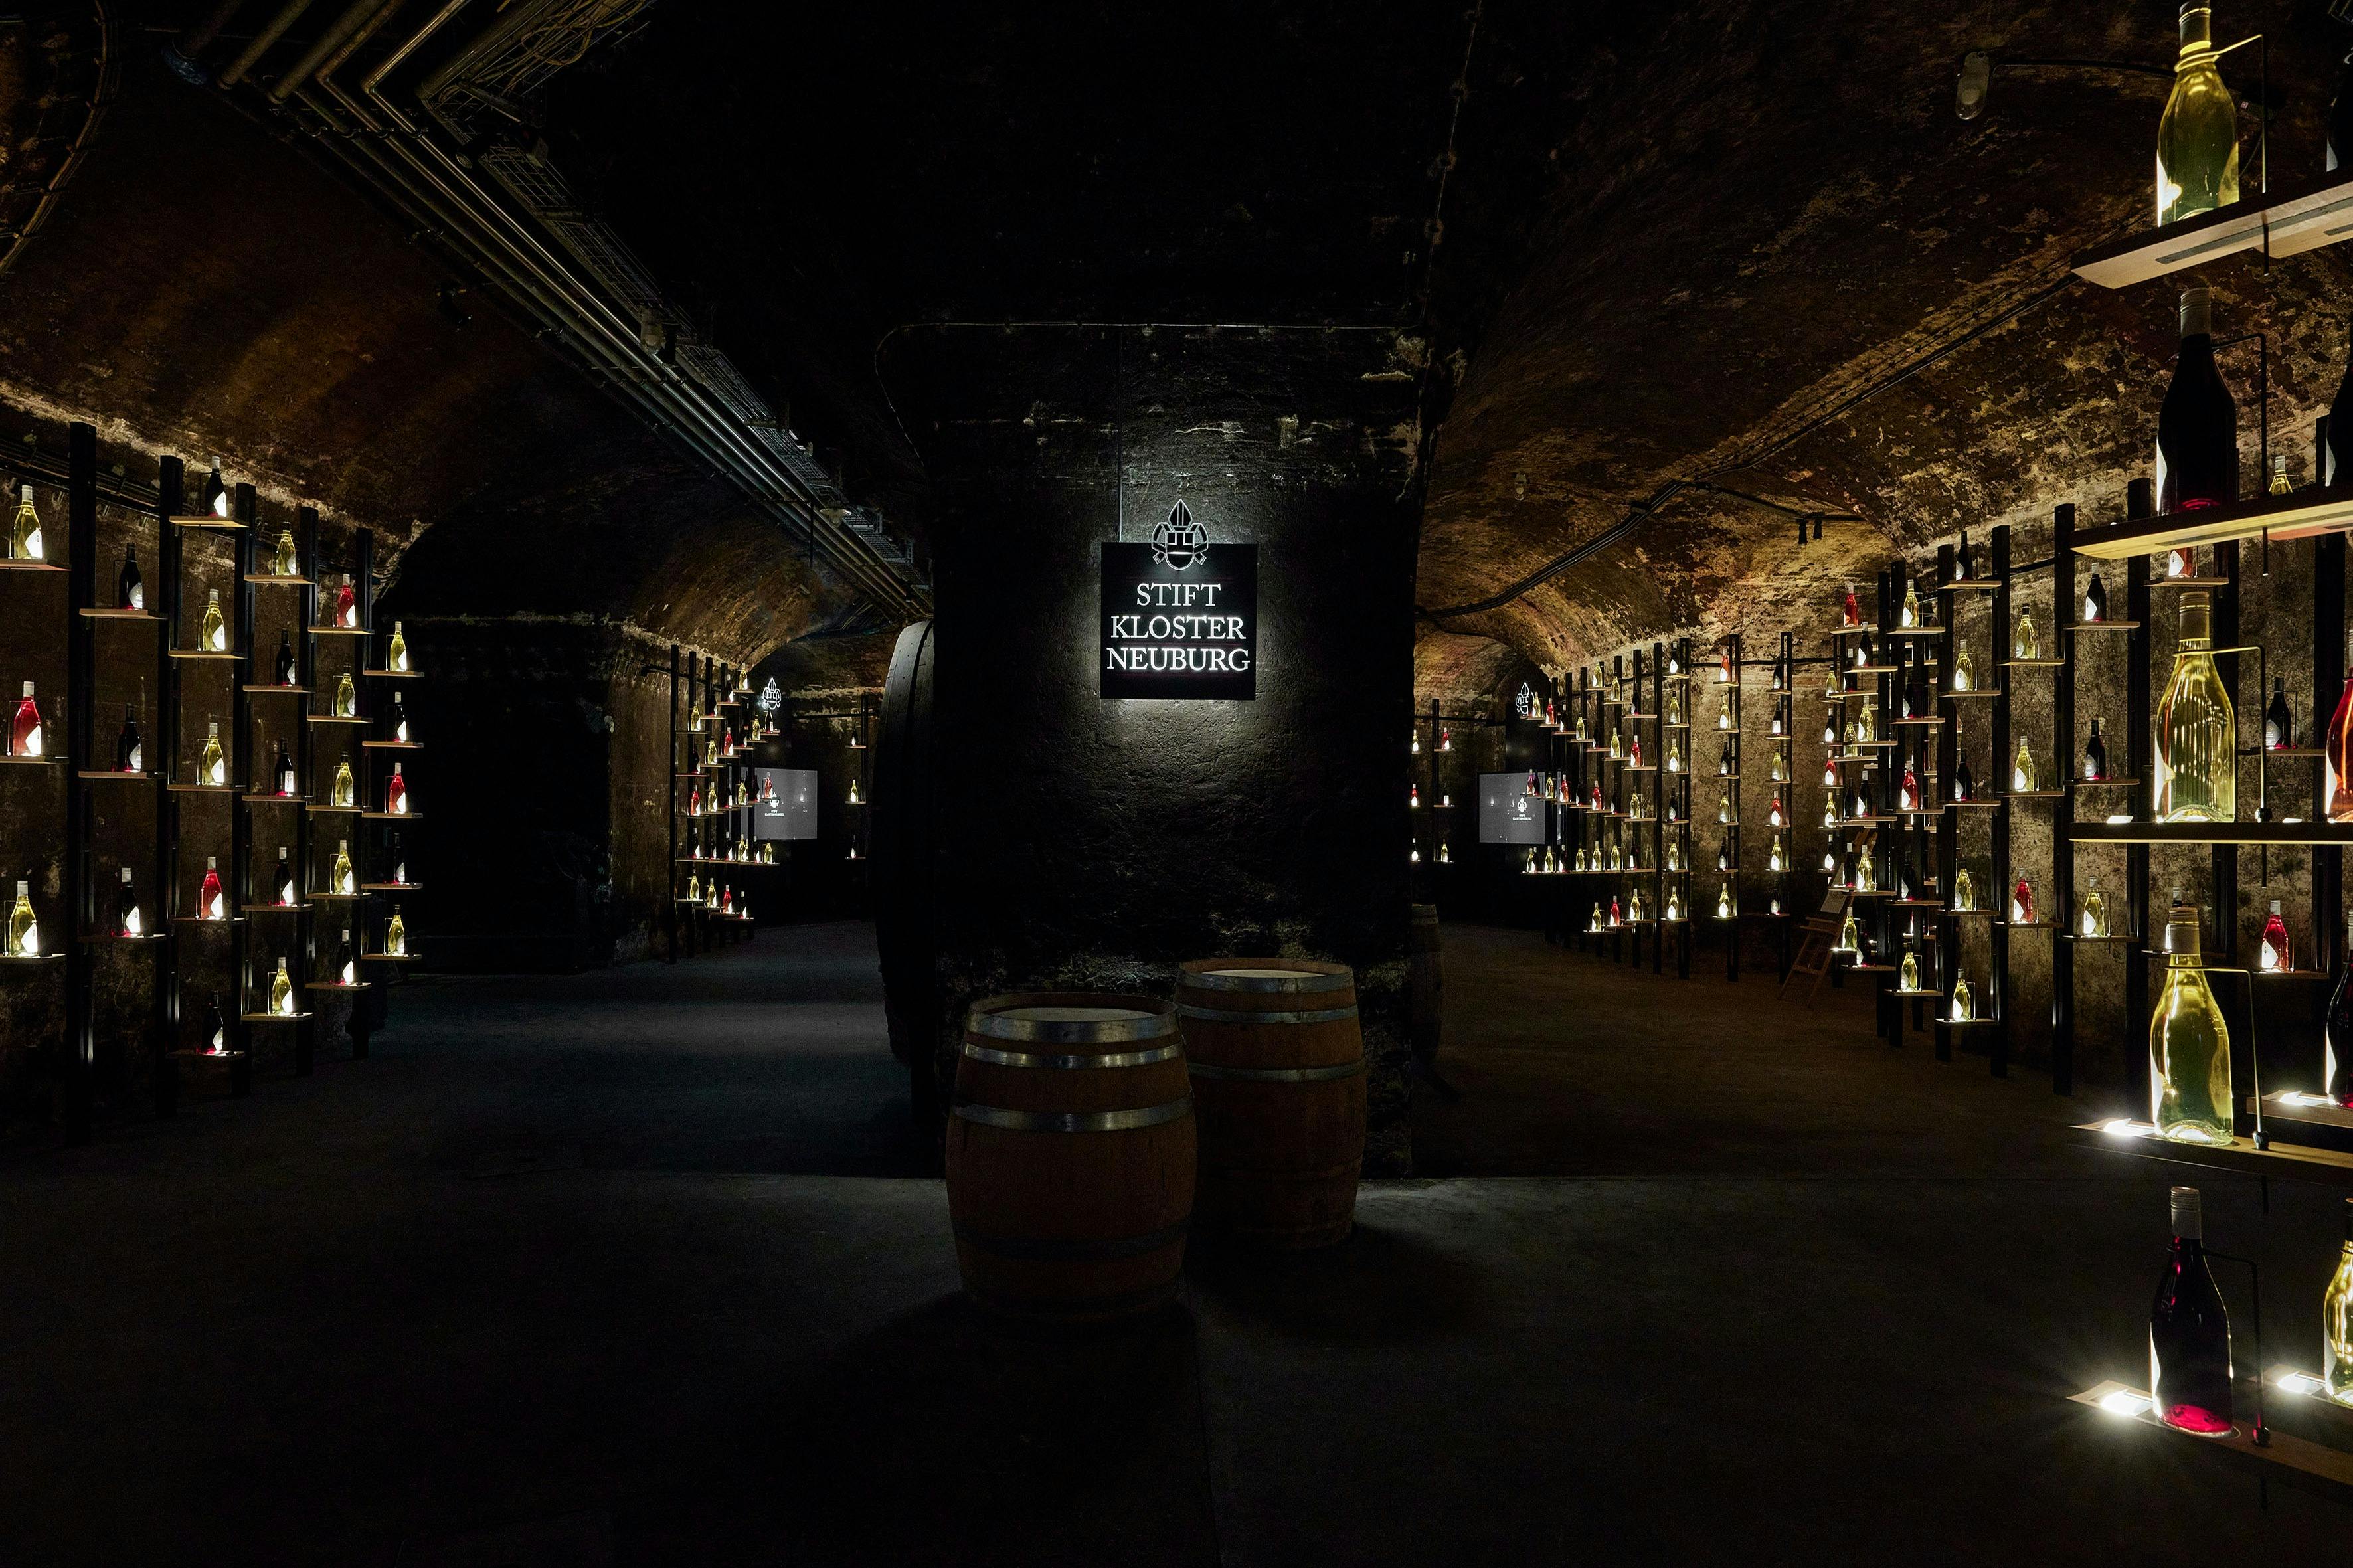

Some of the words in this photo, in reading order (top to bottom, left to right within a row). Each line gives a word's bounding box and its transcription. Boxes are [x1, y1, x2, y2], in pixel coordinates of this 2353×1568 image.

[1136, 583, 1221, 607] STIFT
[1110, 616, 1246, 640] KLOSTER
[1106, 647, 1250, 671] NEUBURG
